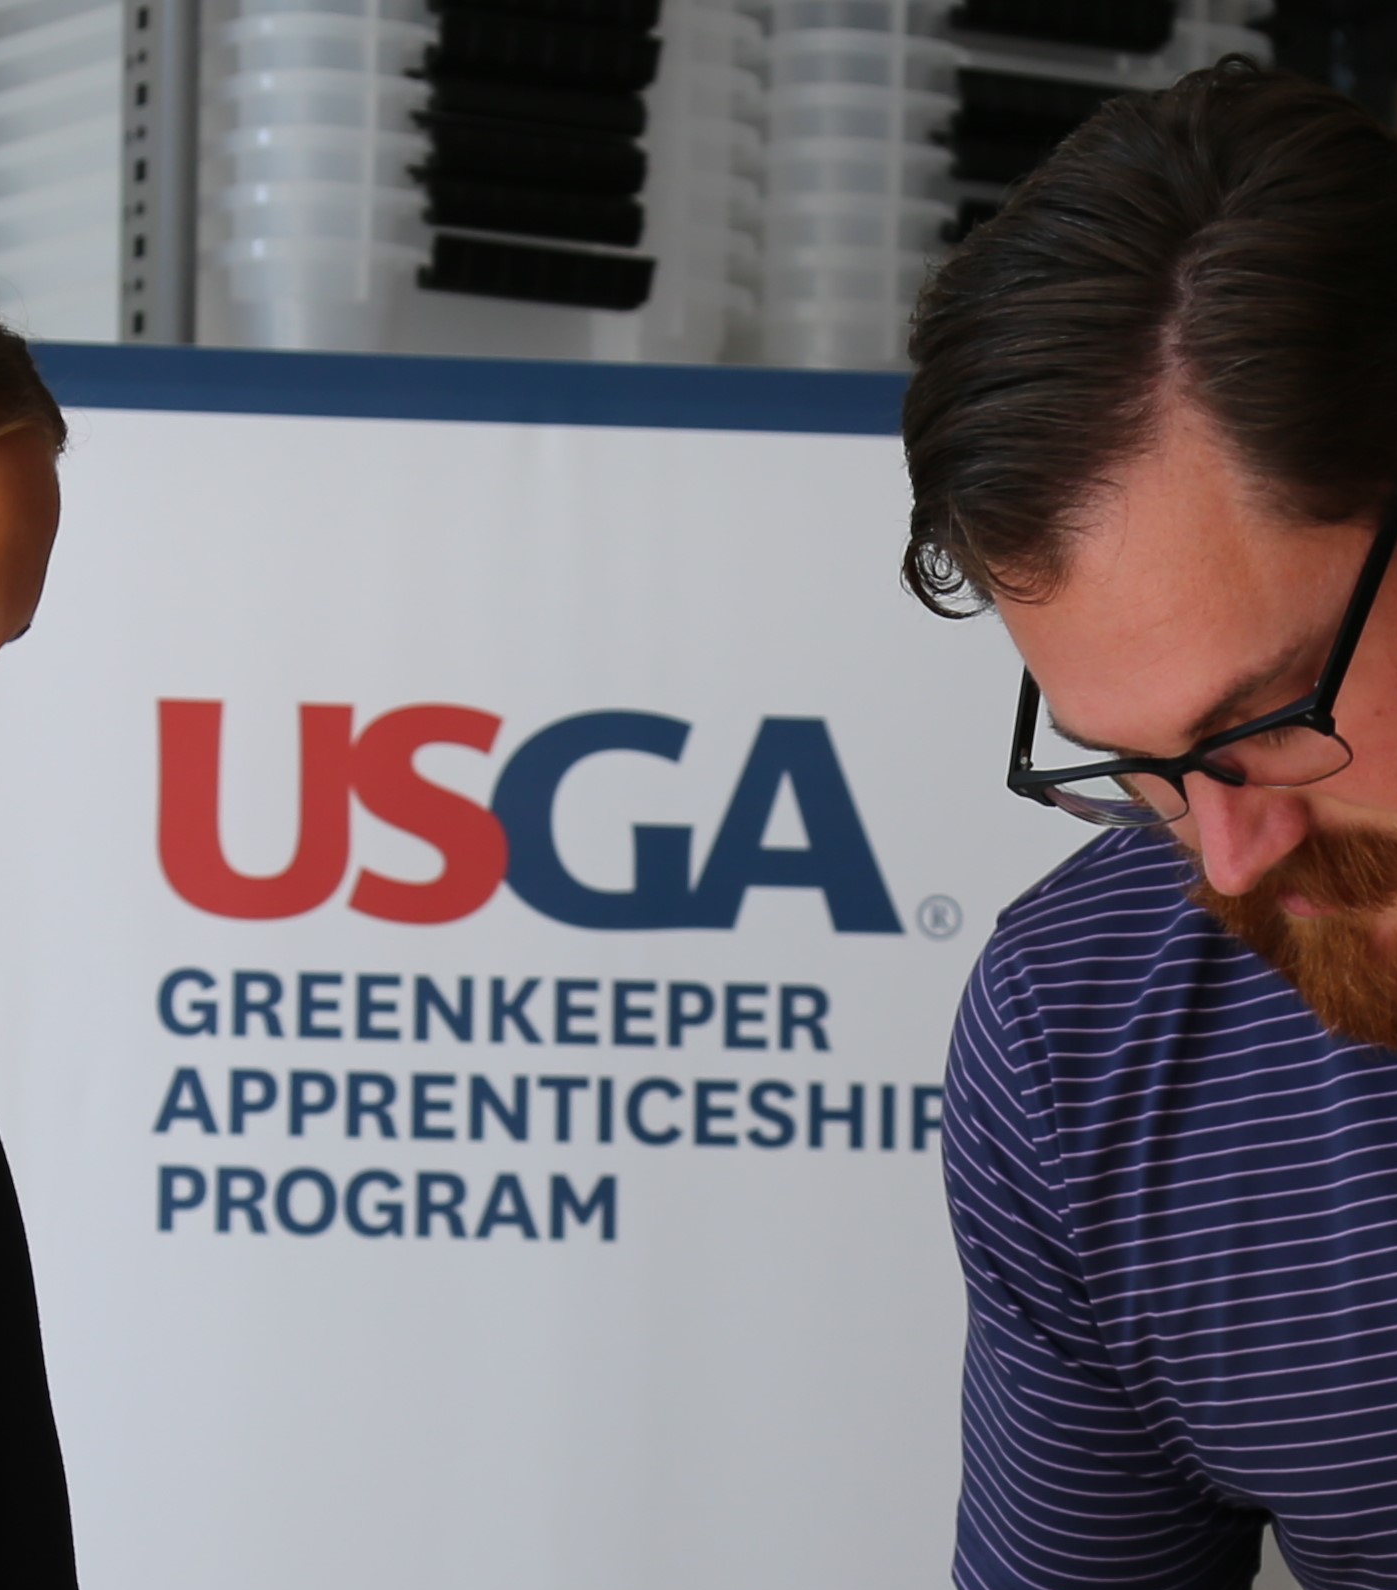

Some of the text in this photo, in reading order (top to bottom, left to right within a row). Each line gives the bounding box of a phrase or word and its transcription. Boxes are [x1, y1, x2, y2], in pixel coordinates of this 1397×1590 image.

[157, 698, 906, 936] USGA
[157, 967, 831, 1052] GREENKEEPER
[153, 1066, 943, 1152] APPRENTICESHIP
[156, 1165, 618, 1242] PROGRAM
